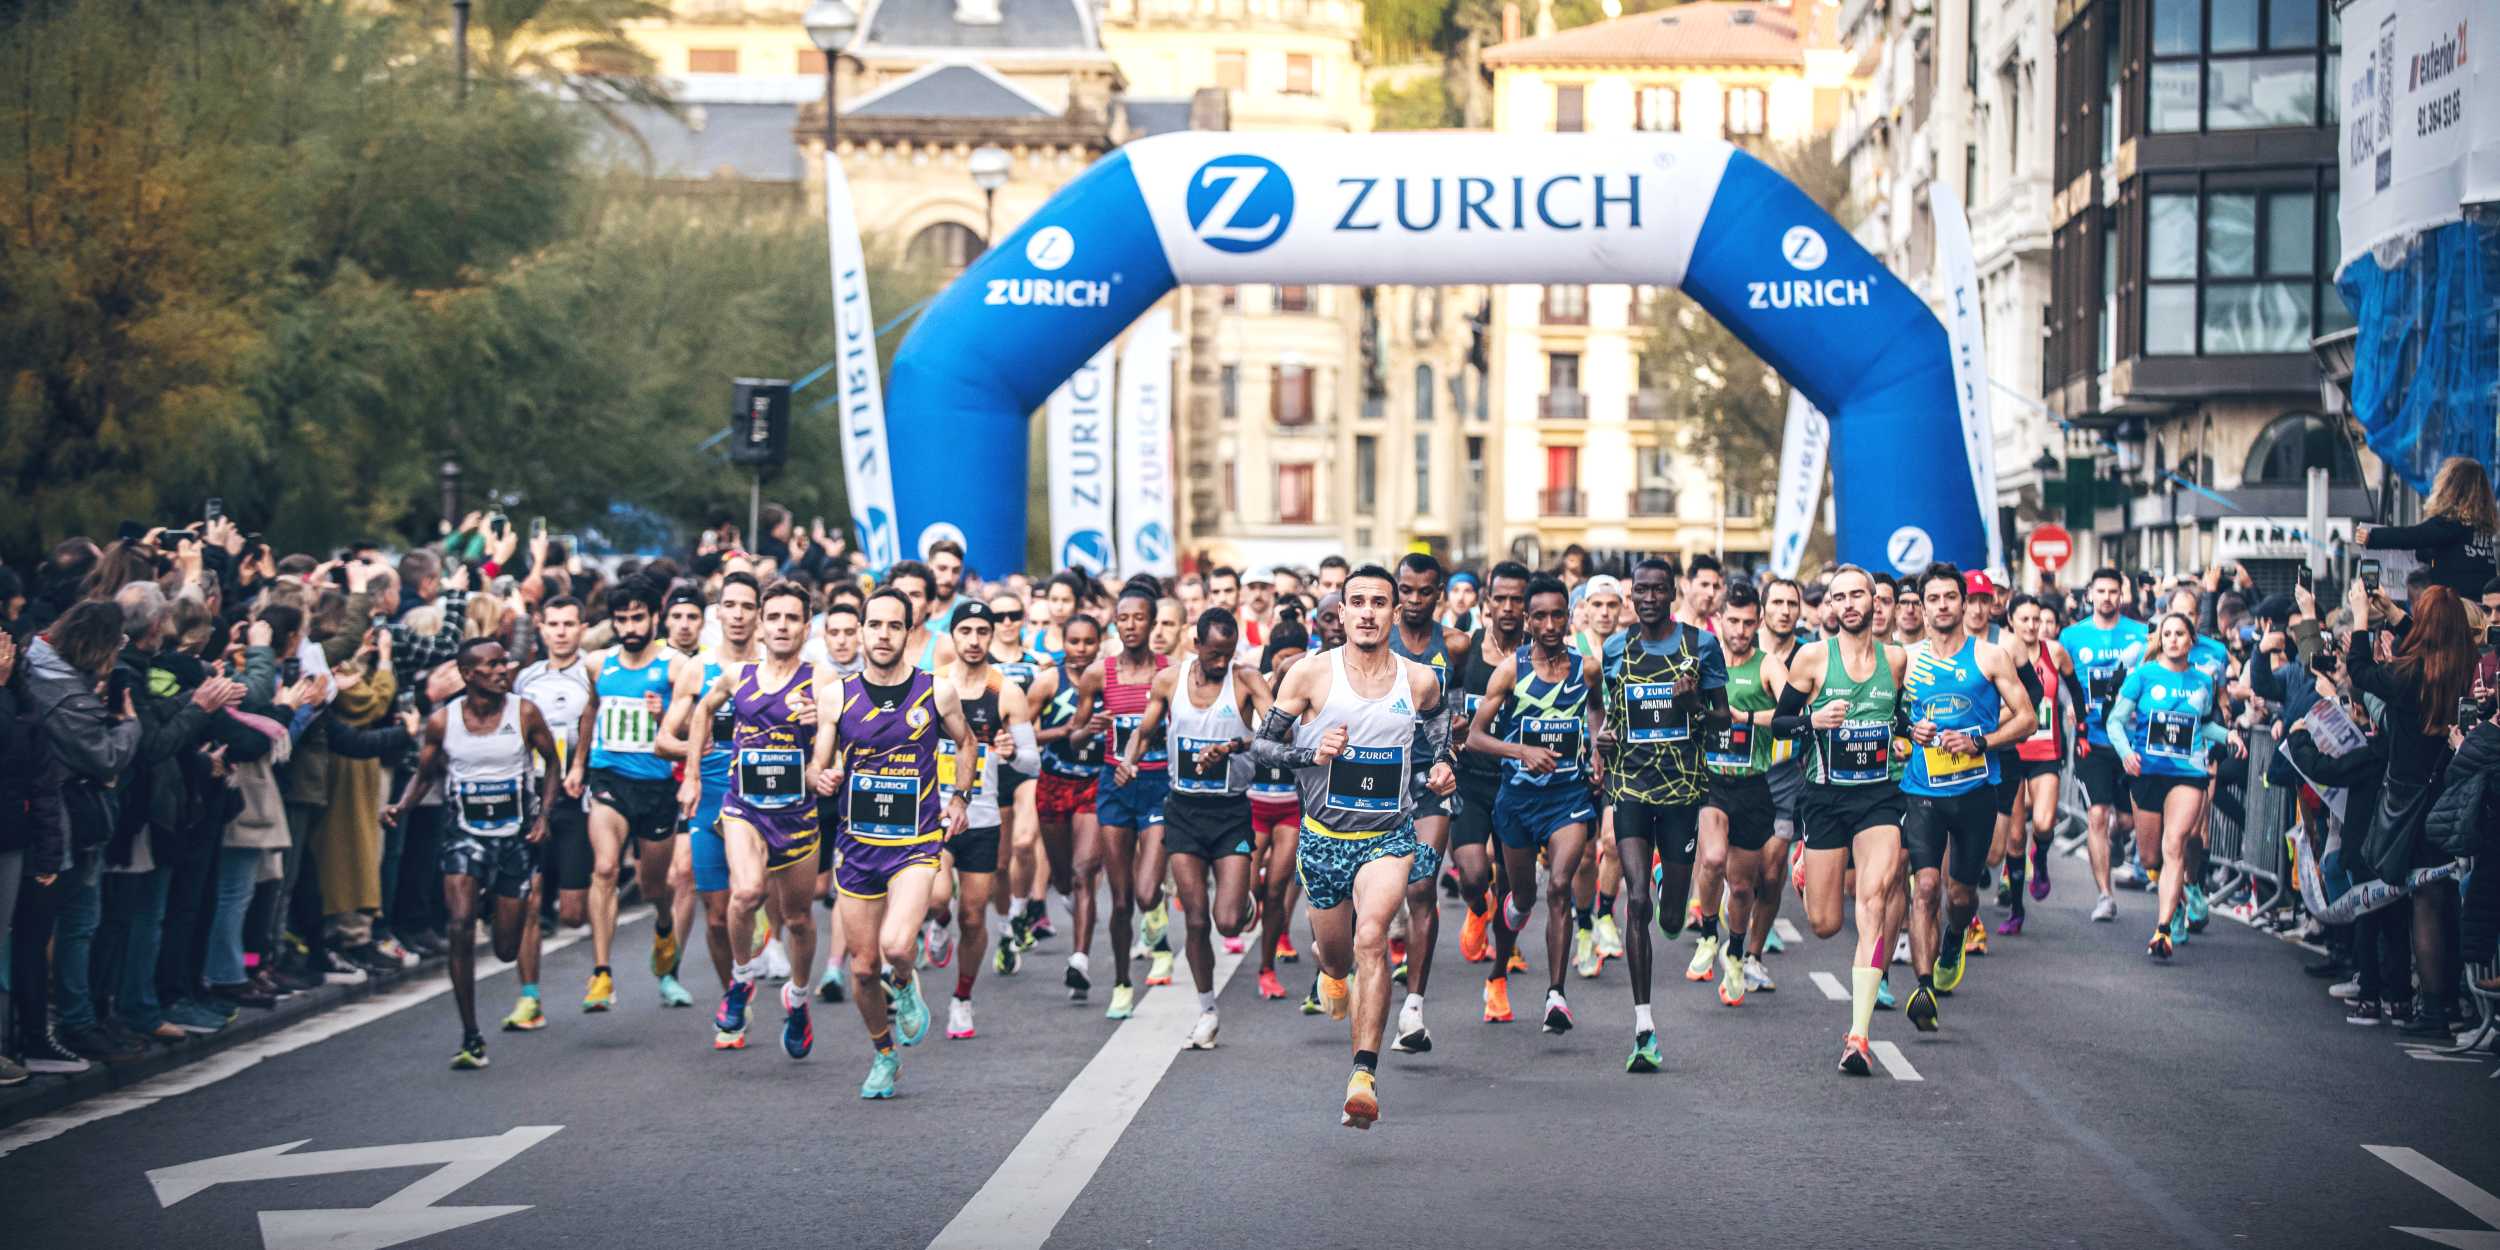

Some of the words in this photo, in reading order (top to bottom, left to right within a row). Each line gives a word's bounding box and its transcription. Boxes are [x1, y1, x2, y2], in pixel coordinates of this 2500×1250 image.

[2420, 32, 2456, 86] exterior
[2457, 18, 2468, 67] 21
[2417, 104, 2427, 138] 91
[2428, 97, 2442, 134] 364
[1333, 173, 1643, 232] ZURICH
[984, 278, 1110, 307] ZURICH
[1747, 279, 1869, 309] ZURICH
[843, 270, 876, 477] ZURICH
[1138, 383, 1164, 504] ZURICH
[2224, 526, 2341, 543] FARMAA
[1640, 699, 1673, 710] JONATHAN
[1544, 722, 1572, 730] ZURICH
[1854, 728, 1882, 738] ZURICH
[1845, 741, 1863, 752] JUAN
[1864, 740, 1878, 751] LUIS
[761, 753, 793, 762] ZURICH
[1359, 751, 1393, 760] ZURICH
[1856, 752, 1868, 765] 33
[765, 776, 777, 789] 15
[874, 781, 908, 790] ZURICH
[1360, 777, 1374, 791] 43
[874, 793, 894, 804] JUAN
[878, 804, 890, 818] 14
